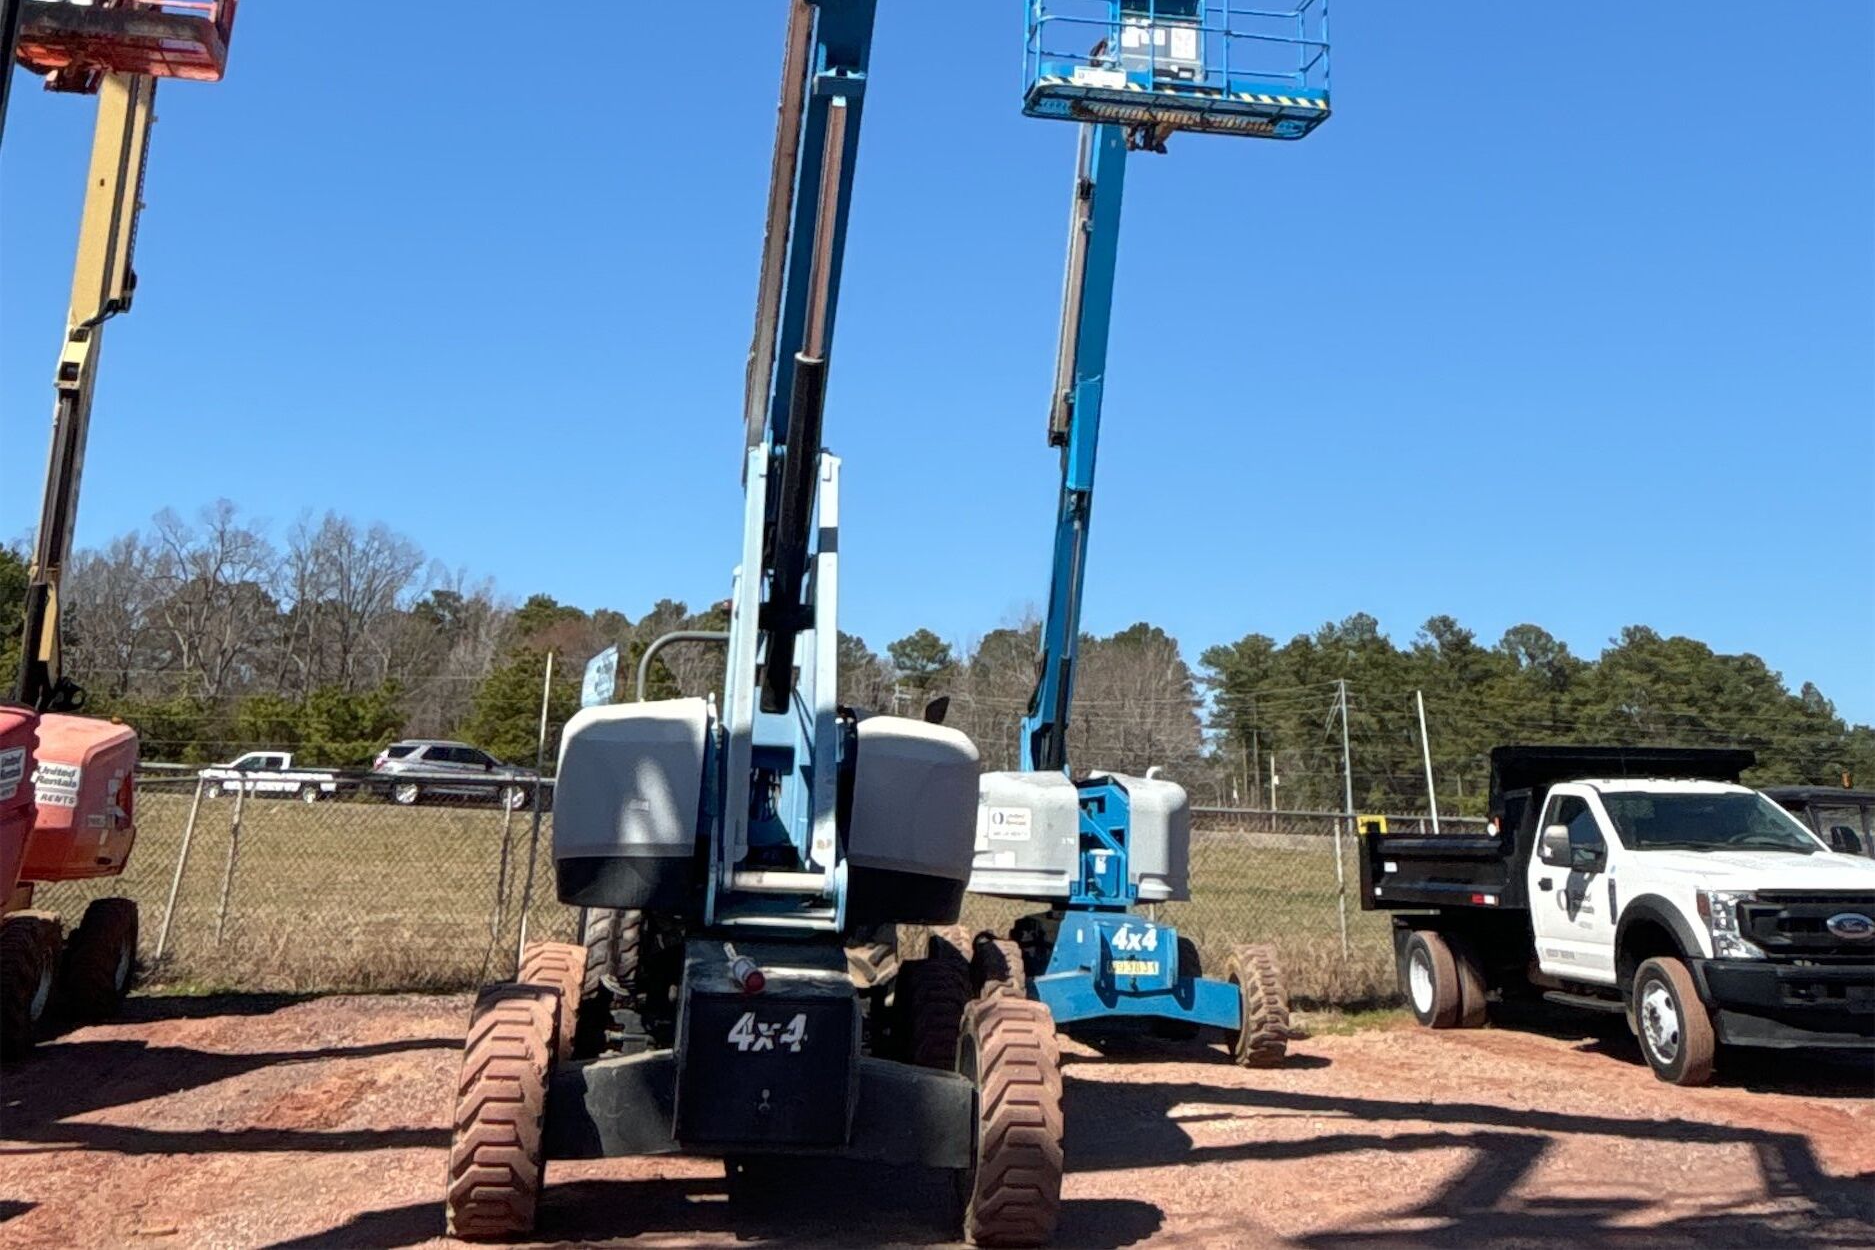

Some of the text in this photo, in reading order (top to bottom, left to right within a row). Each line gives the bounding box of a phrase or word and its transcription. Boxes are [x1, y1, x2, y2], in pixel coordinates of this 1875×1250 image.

[37, 766, 77, 777] United
[36, 775, 77, 788] Rentals
[40, 793, 76, 804] RENTS
[1111, 926, 1158, 952] 4x4
[727, 1012, 808, 1052] 4x4
